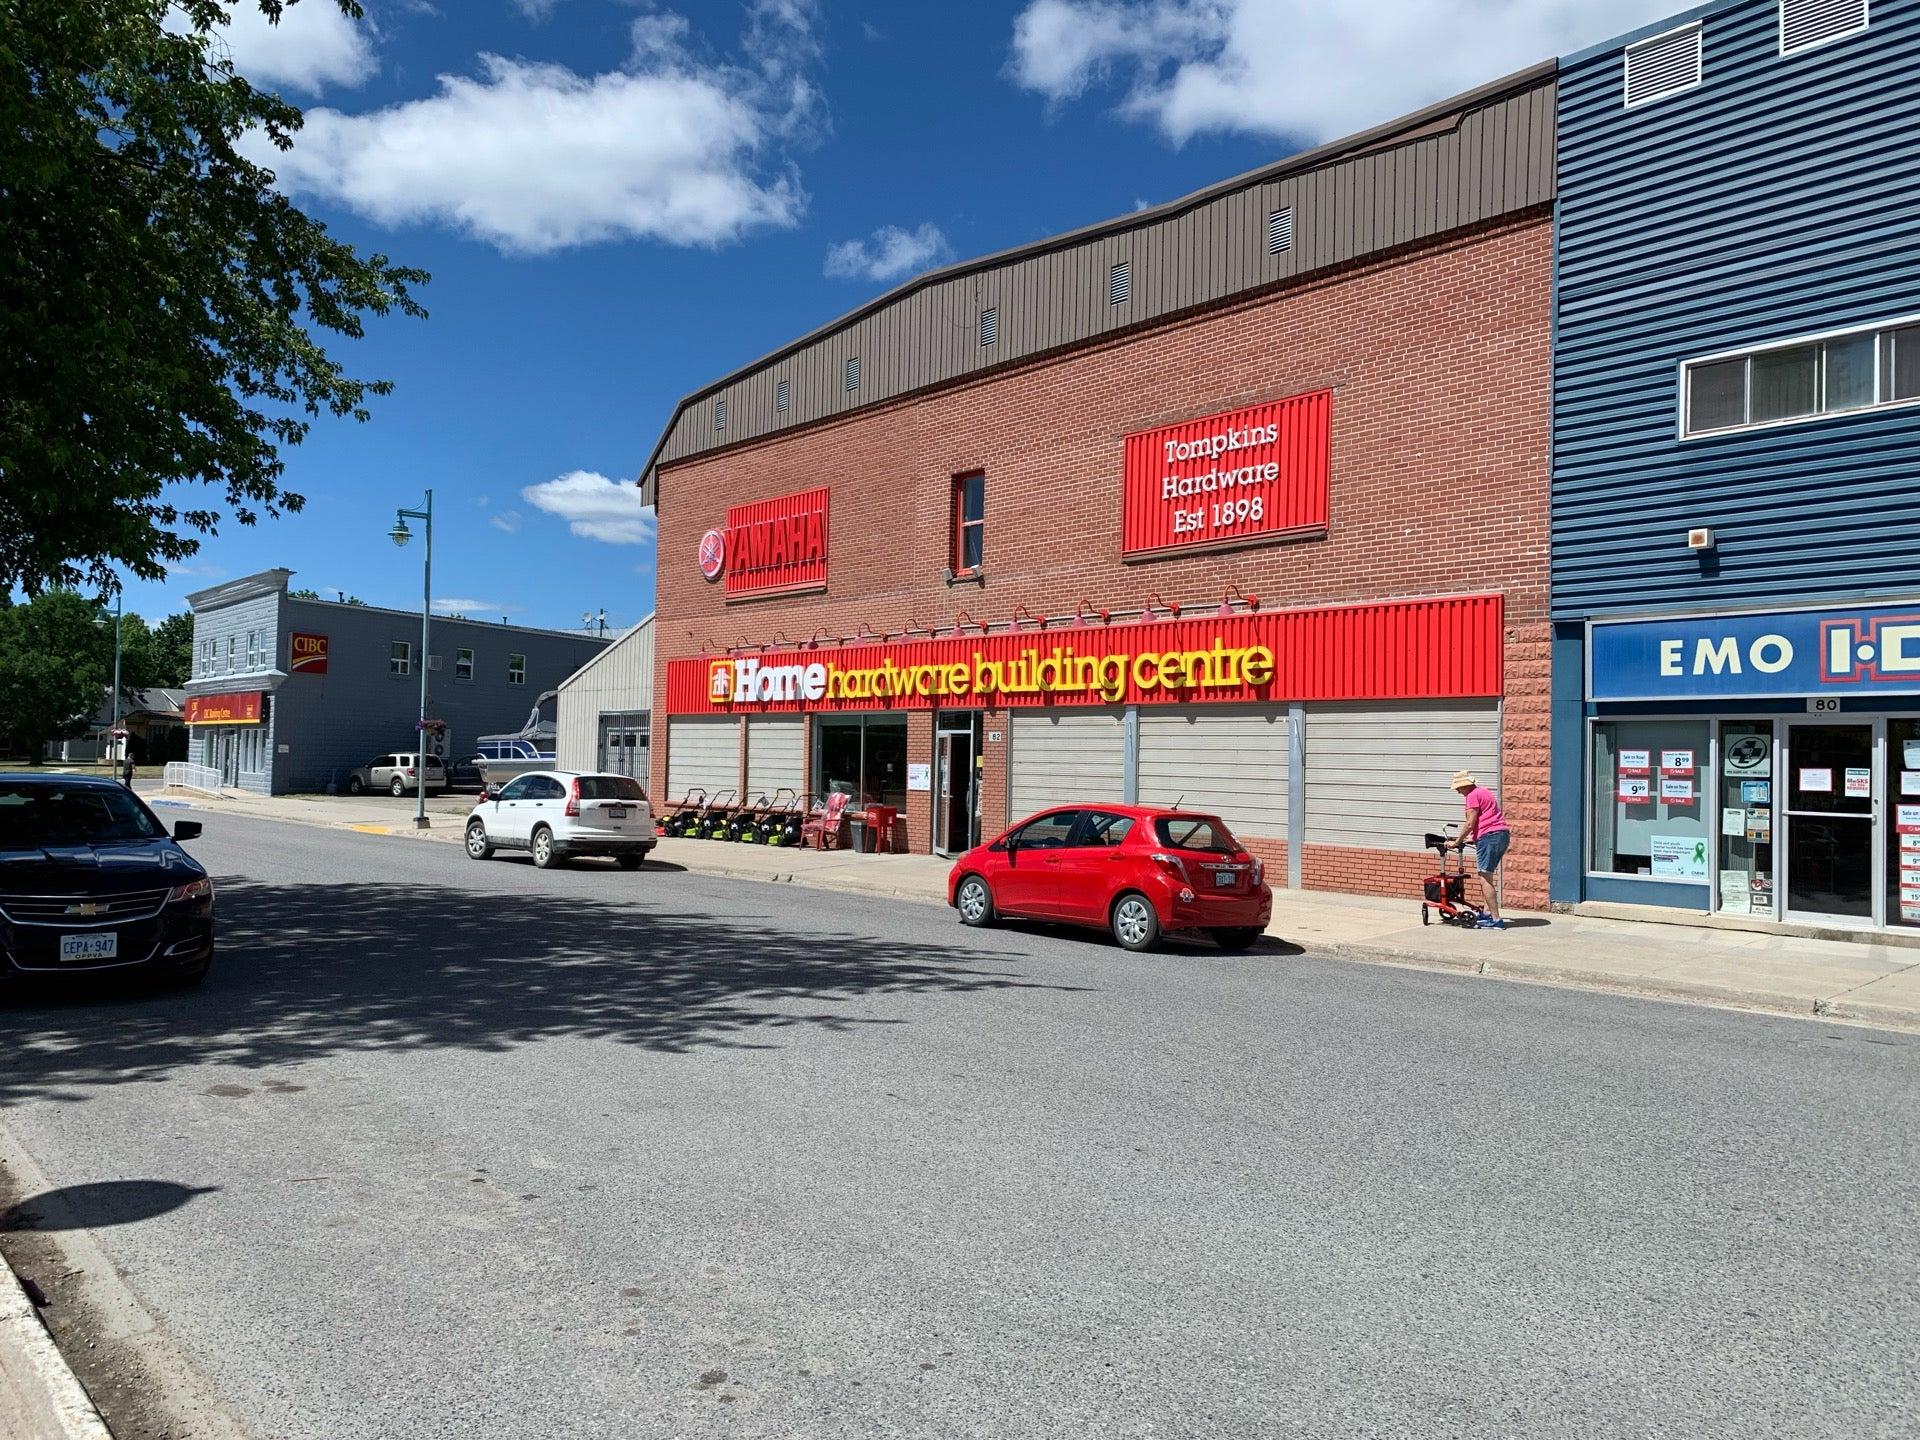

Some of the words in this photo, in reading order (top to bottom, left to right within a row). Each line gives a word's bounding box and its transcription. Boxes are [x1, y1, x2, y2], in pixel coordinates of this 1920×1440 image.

[1165, 423, 1278, 463] Tompkins
[1162, 461, 1279, 500] Hardware
[1173, 507, 1205, 533] Est
[1212, 496, 1264, 527] 1898
[721, 510, 825, 574] YAMAHA
[294, 637, 326, 654] CIBC
[1660, 634, 1794, 676] EMO
[734, 658, 826, 702] Home
[826, 658, 970, 699] hardware
[973, 647, 1129, 701] building
[1133, 636, 1274, 689] centre
[1816, 700, 1837, 710] 80
